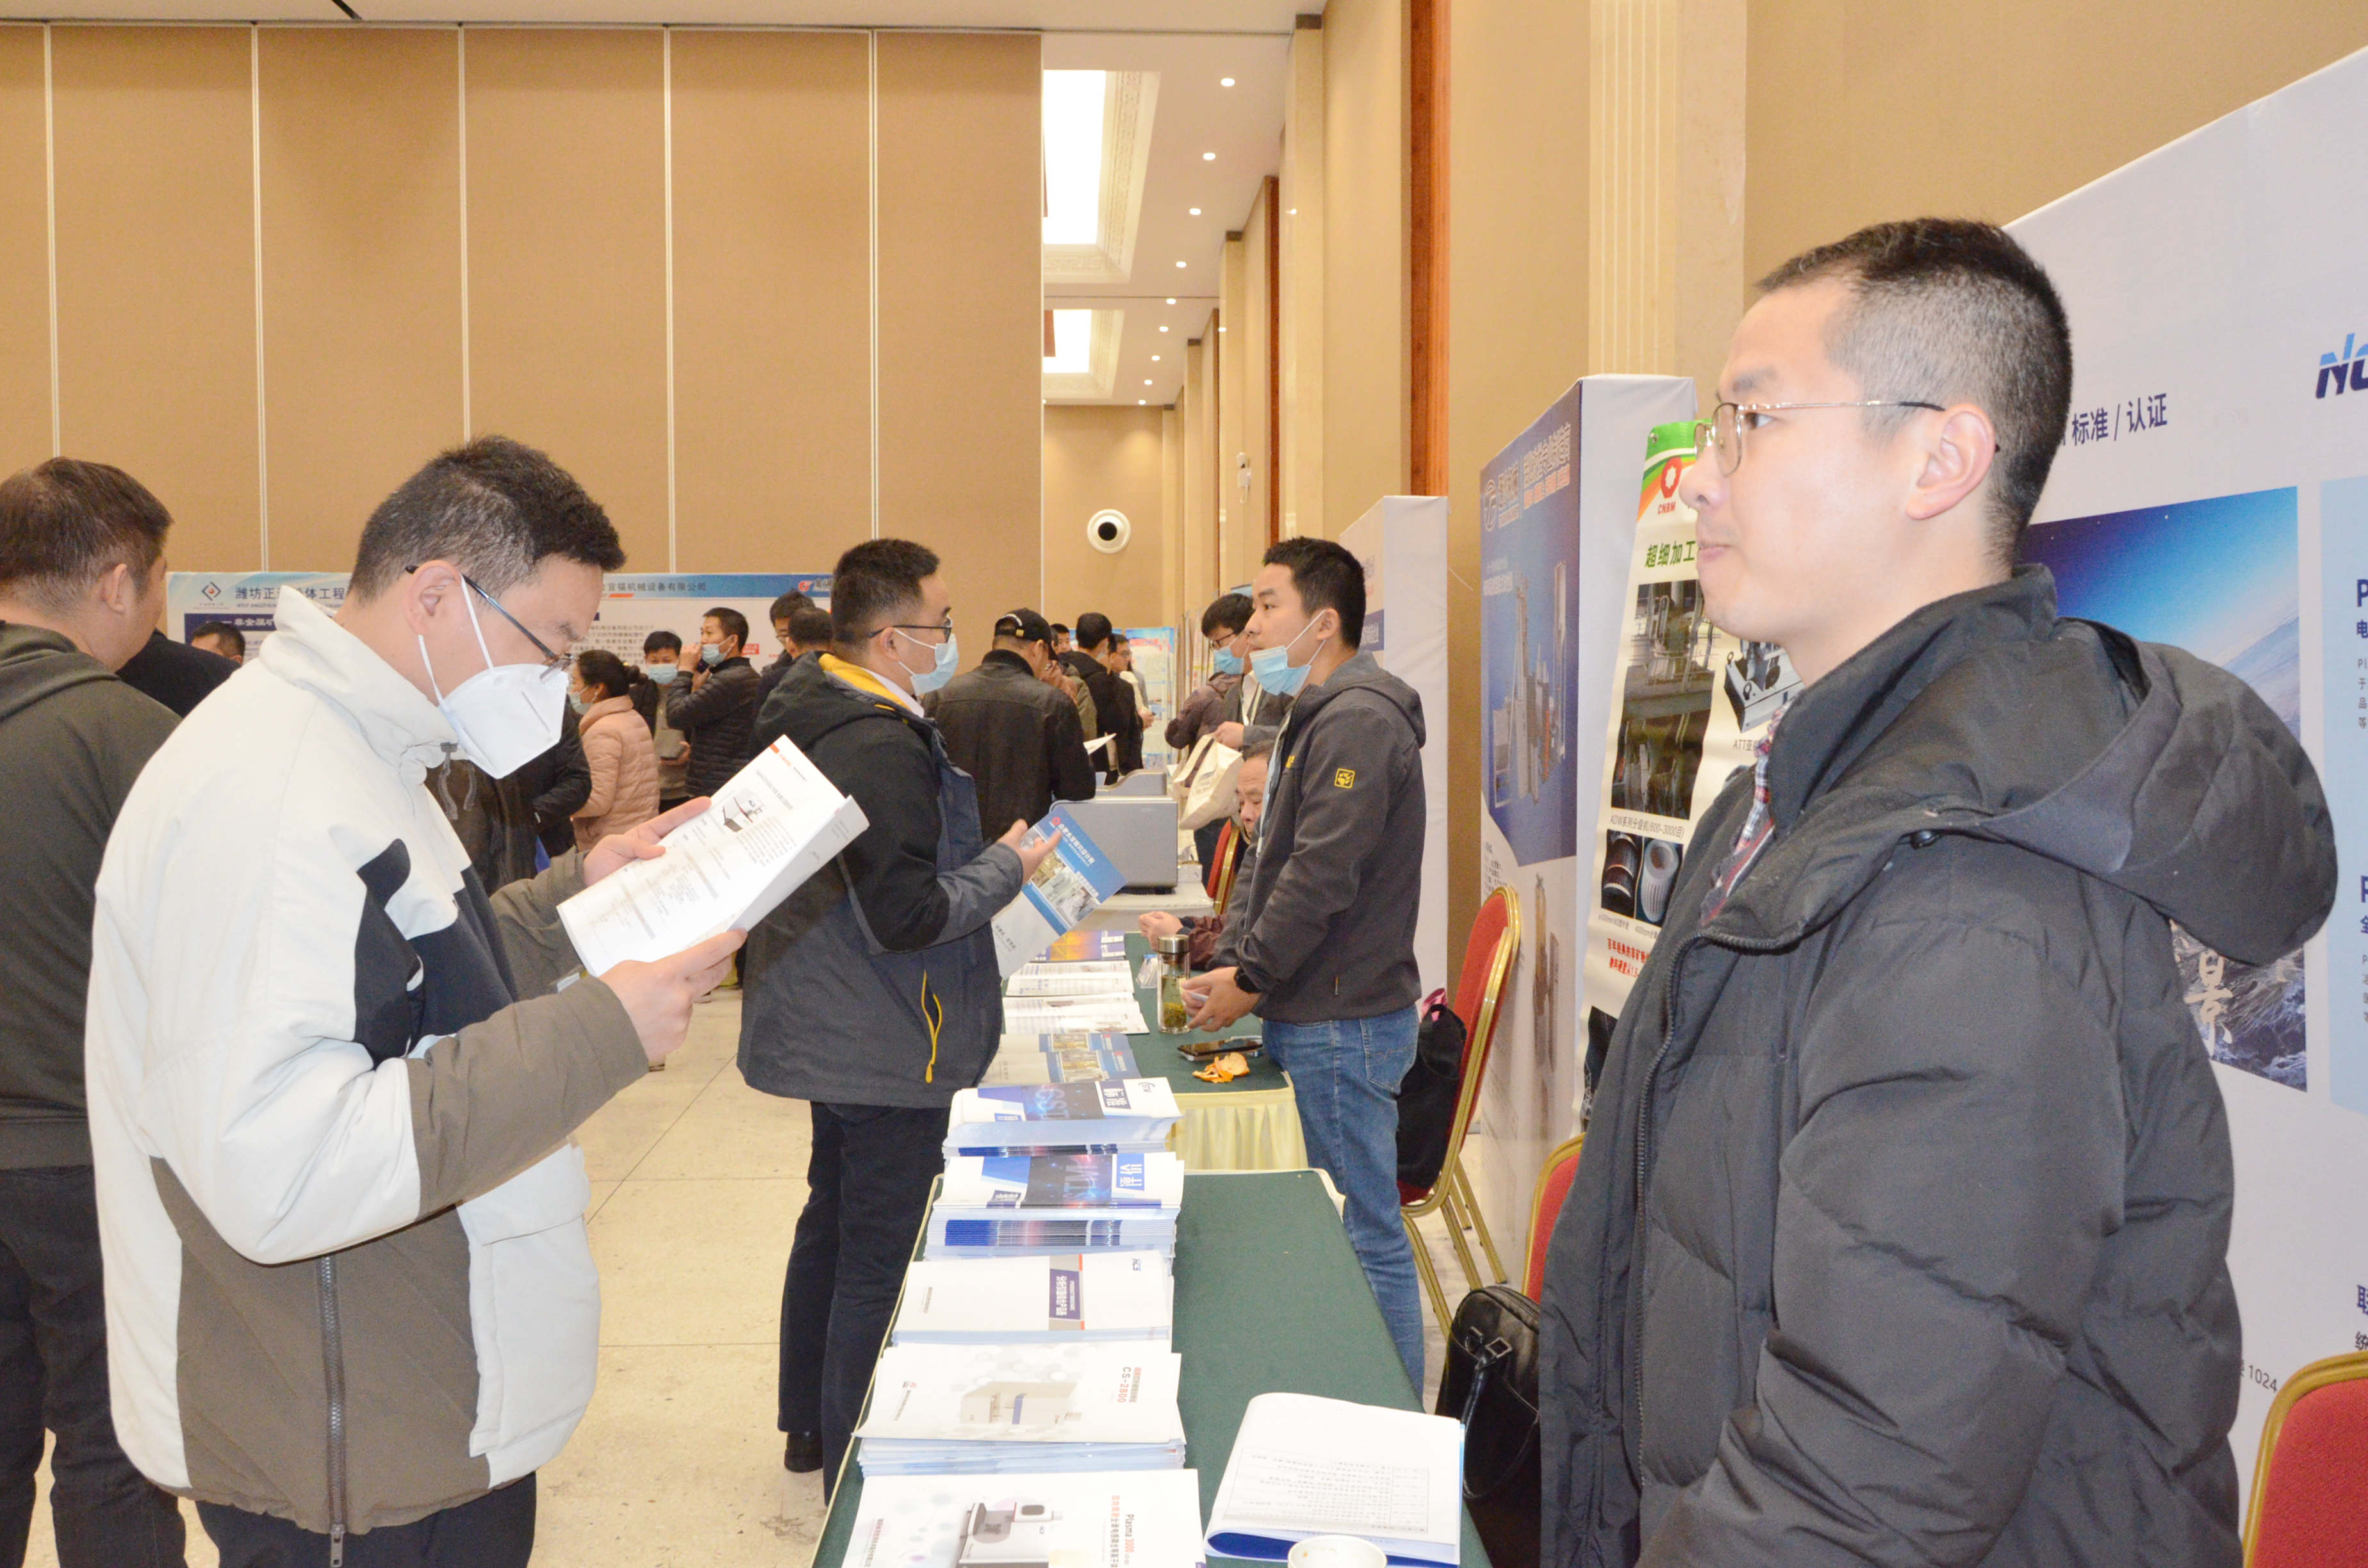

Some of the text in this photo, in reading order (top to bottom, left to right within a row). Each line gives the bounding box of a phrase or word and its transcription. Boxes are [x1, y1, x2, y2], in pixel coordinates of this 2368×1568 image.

[1657, 501, 1677, 515] CNBM
[1645, 540, 1695, 568] 超细加工
[1104, 1087, 1128, 1107] 标准
[1119, 1163, 1142, 1187] 评价
[1117, 1366, 1131, 1403] CS-2800
[2248, 1365, 2278, 1392] 1024
[1125, 1514, 1135, 1537] Plasma
[1125, 1538, 1135, 1553] 3000
